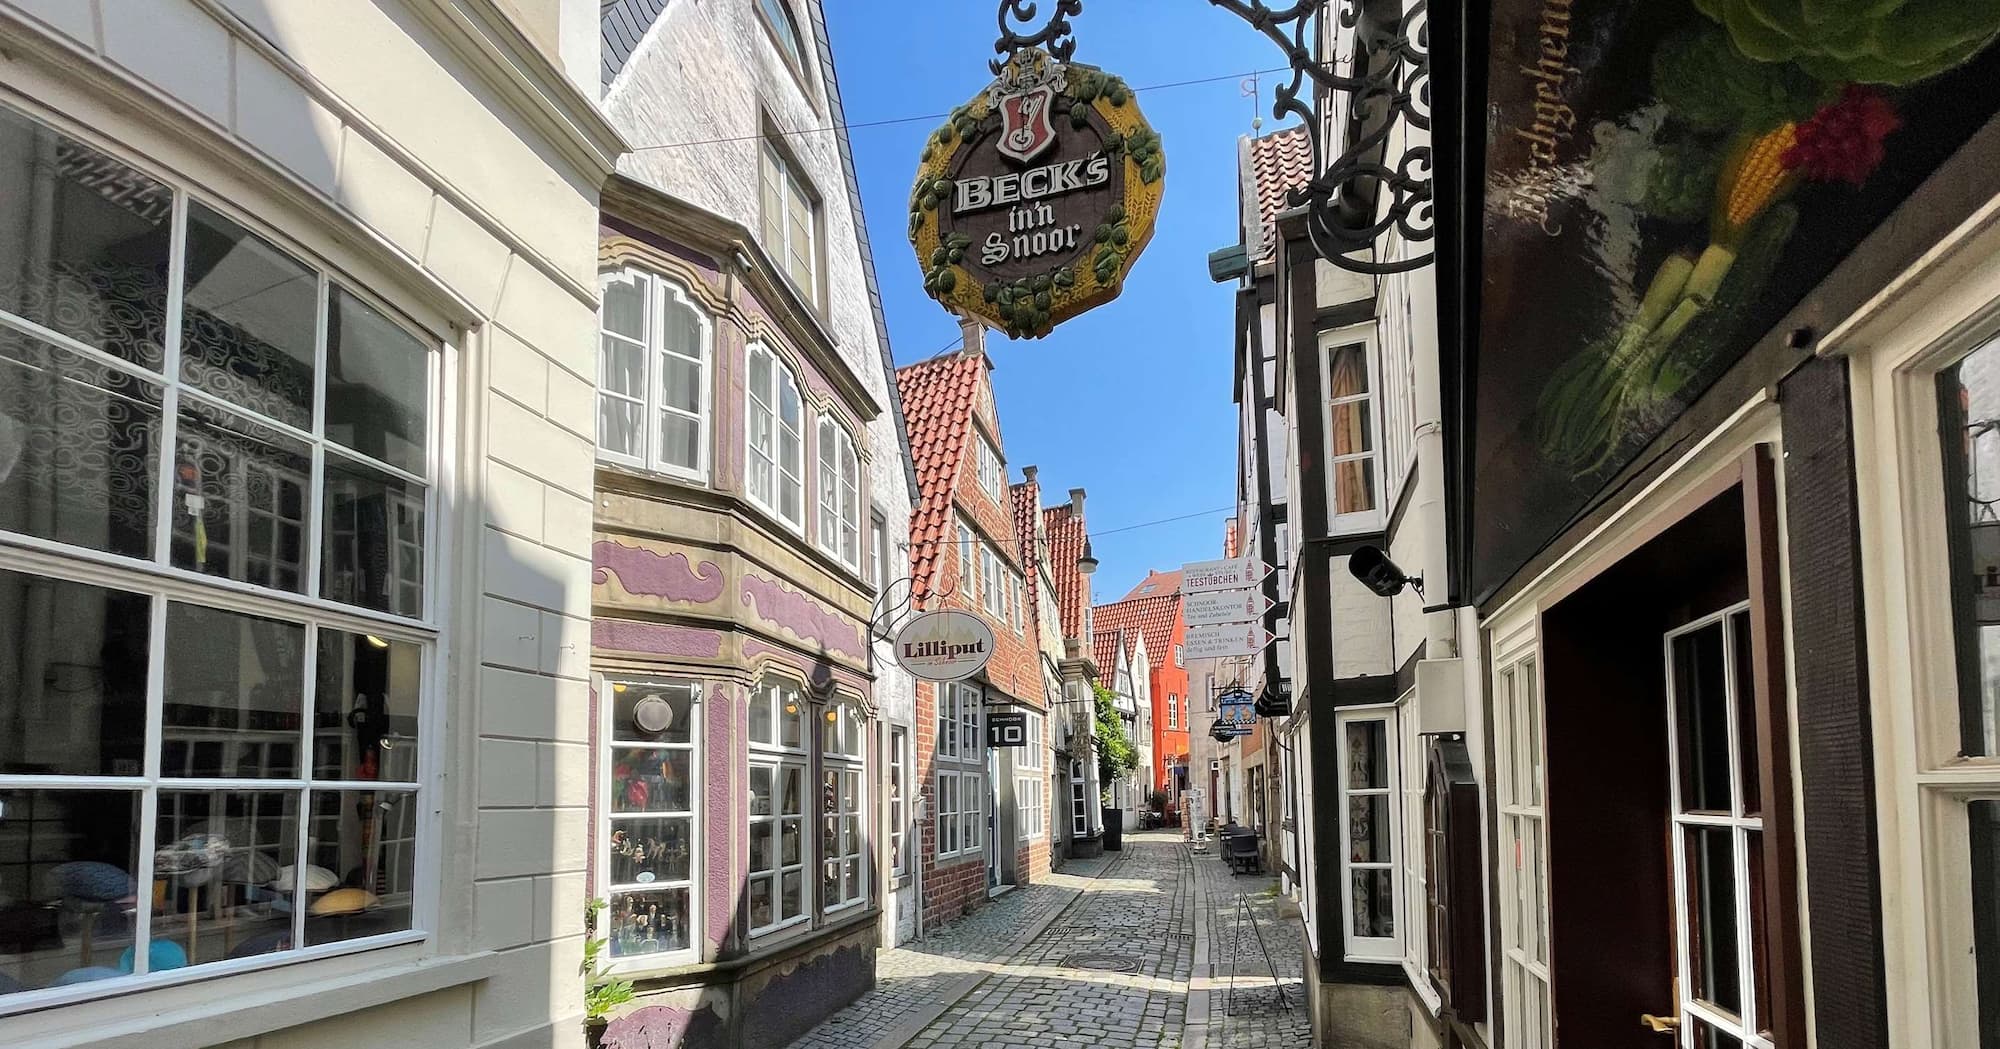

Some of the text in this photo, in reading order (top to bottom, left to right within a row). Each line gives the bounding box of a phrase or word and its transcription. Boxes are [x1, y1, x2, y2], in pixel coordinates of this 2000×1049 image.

[981, 223, 1081, 265] Snoor
[1186, 574, 1239, 588] TEESTÜBCHEN
[1186, 603, 1243, 614] HANDELSKONTOR
[904, 638, 985, 660] Lilliput
[991, 725, 1022, 743] 10
